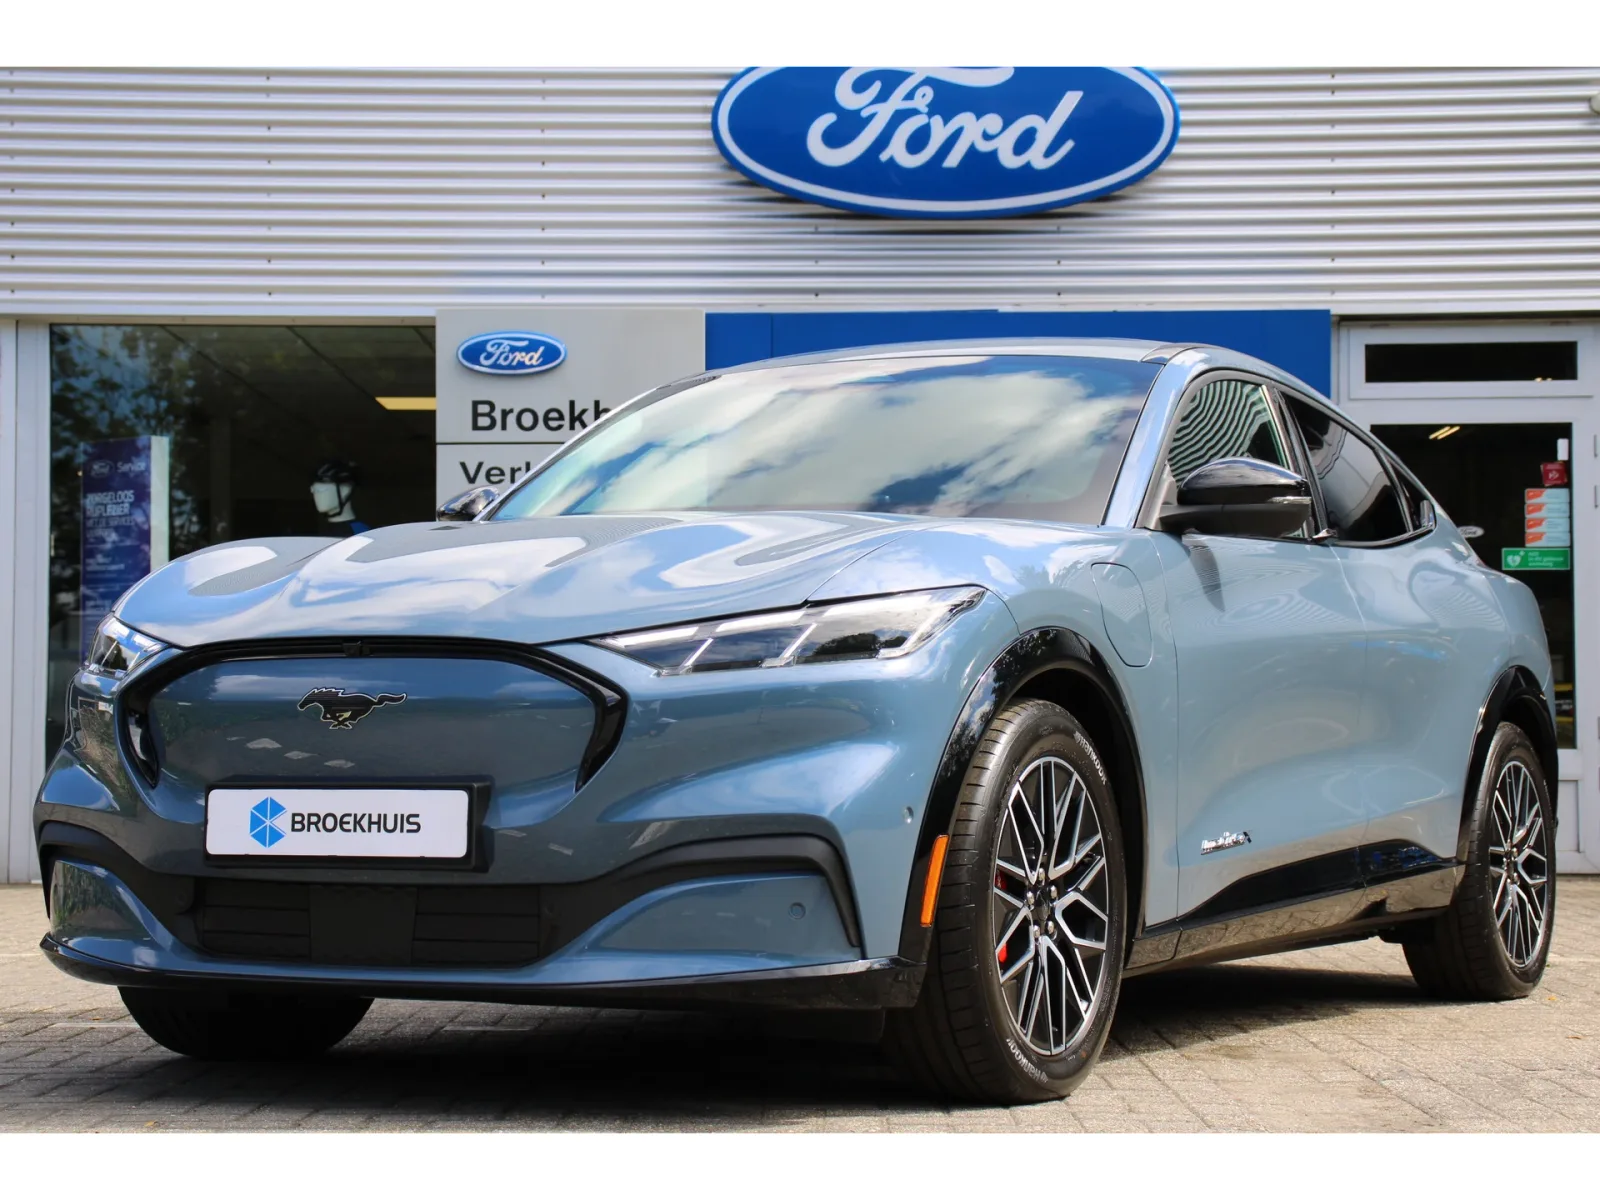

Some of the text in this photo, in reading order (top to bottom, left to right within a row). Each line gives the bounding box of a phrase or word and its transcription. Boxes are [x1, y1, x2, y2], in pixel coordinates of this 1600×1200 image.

[806, 66, 1084, 171] Ford
[479, 339, 546, 367] Ford
[291, 812, 421, 834] BROEKHUIS
